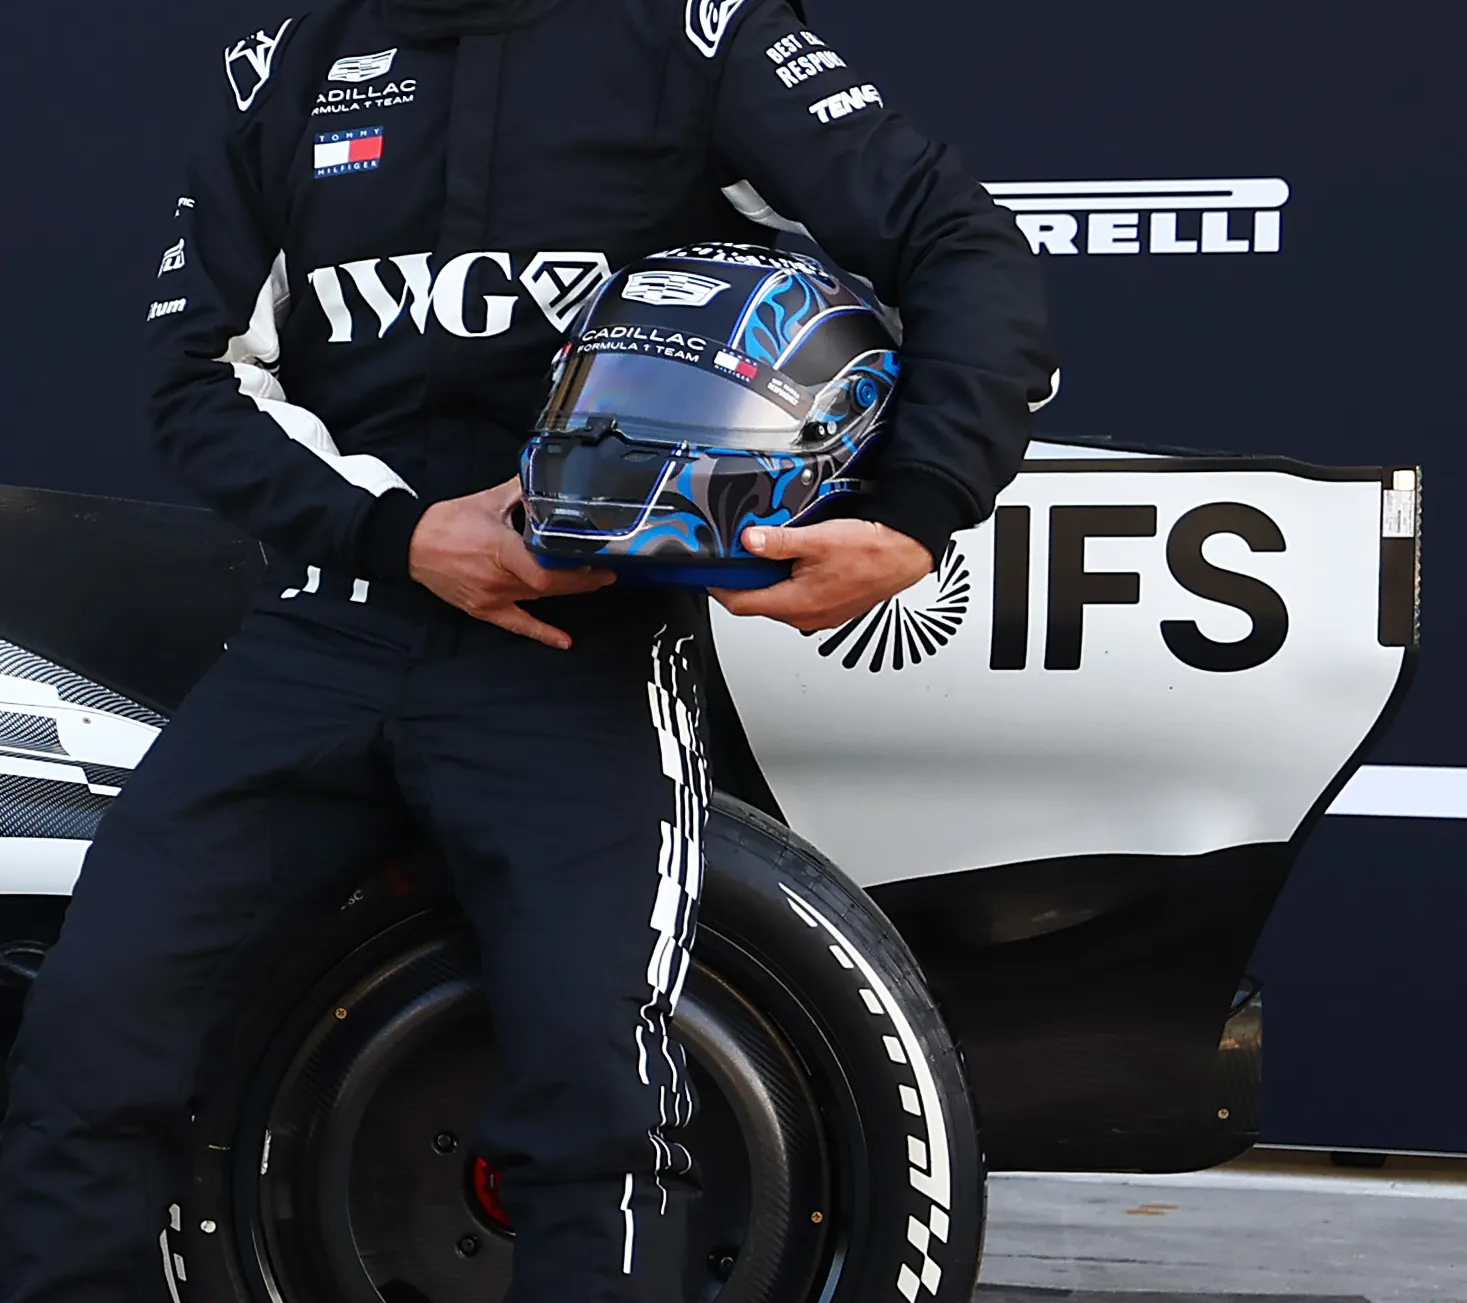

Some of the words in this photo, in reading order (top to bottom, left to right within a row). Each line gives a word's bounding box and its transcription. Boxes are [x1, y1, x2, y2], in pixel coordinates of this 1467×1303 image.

[766, 33, 803, 65] BEST
[316, 79, 418, 103] ADILLAC
[311, 103, 360, 116] RMULA
[375, 95, 414, 108] TEAM
[319, 128, 380, 142] TOMMY
[317, 160, 377, 175] HILFIGER
[990, 181, 1288, 254] RELLI
[307, 250, 521, 344] TWG
[581, 326, 708, 351] CADILLAC
[577, 343, 638, 354] FORMULA
[655, 345, 700, 364] TEAM
[989, 501, 1290, 673] IFS
